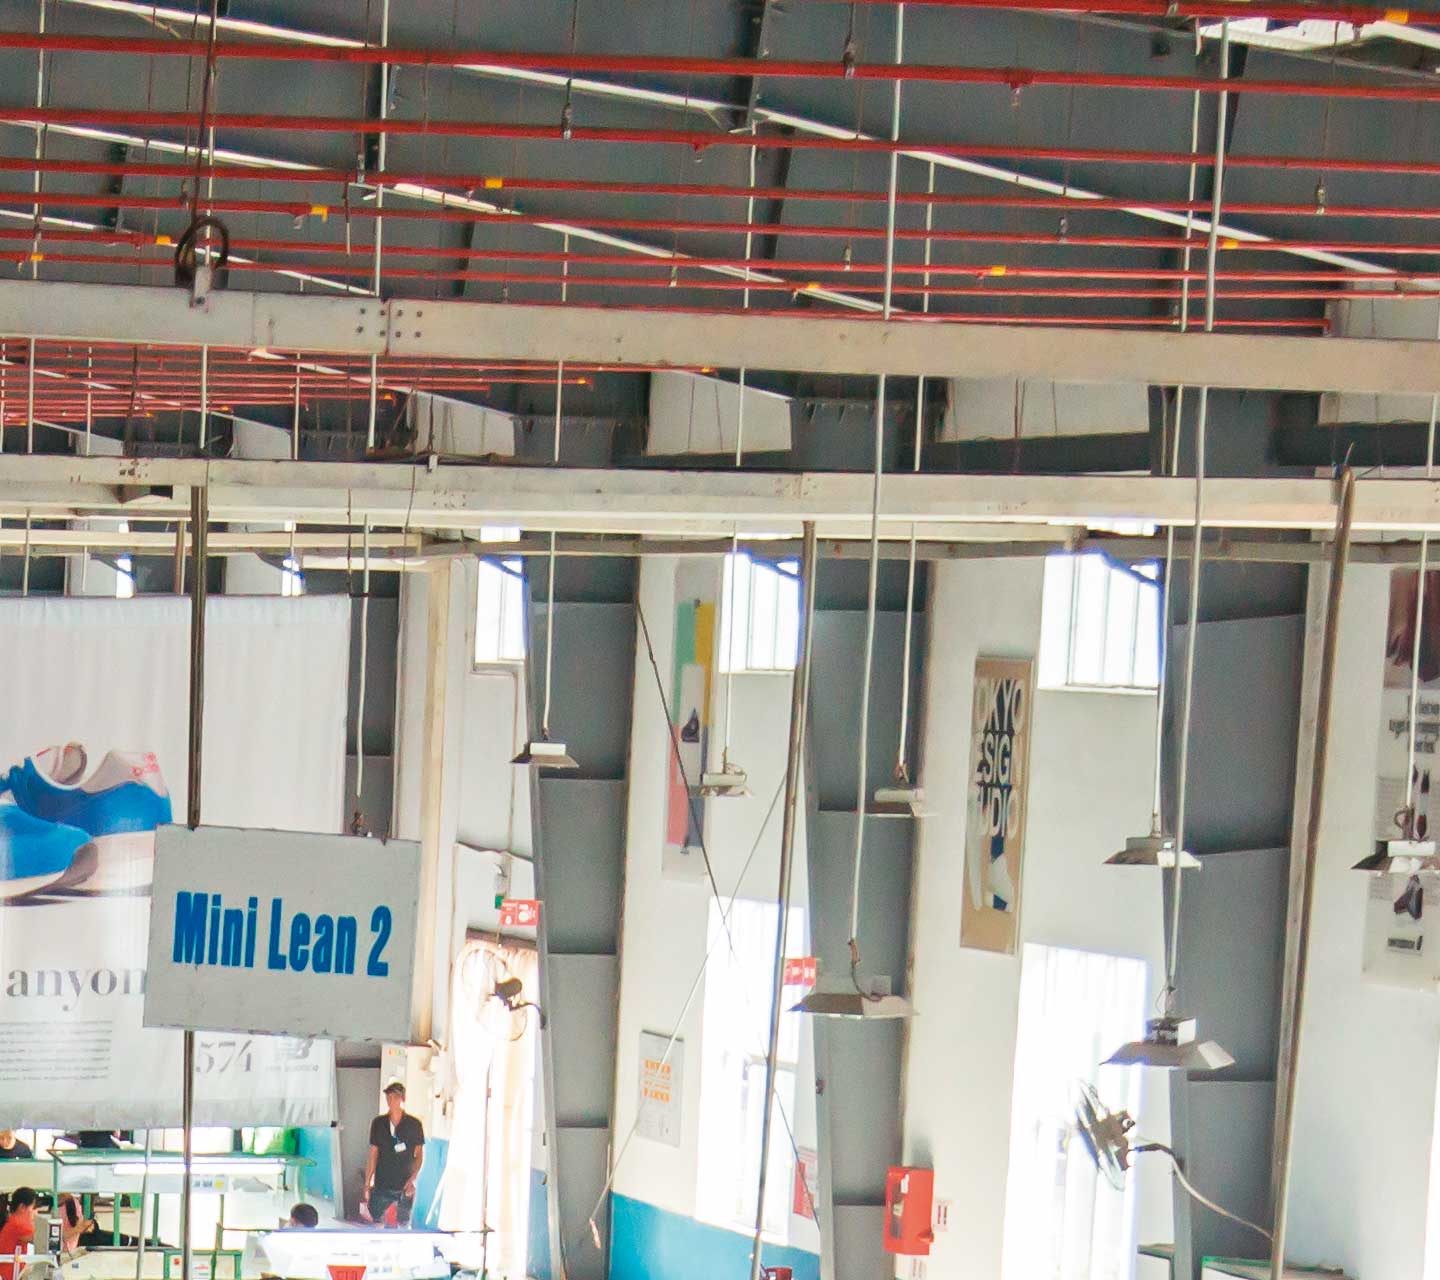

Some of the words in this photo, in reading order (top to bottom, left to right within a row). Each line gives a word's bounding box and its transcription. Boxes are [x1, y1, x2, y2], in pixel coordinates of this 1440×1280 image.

[173, 890, 258, 970] Mini
[267, 896, 360, 975] Lean
[368, 904, 391, 977] 2
[195, 1039, 253, 1074] 574
